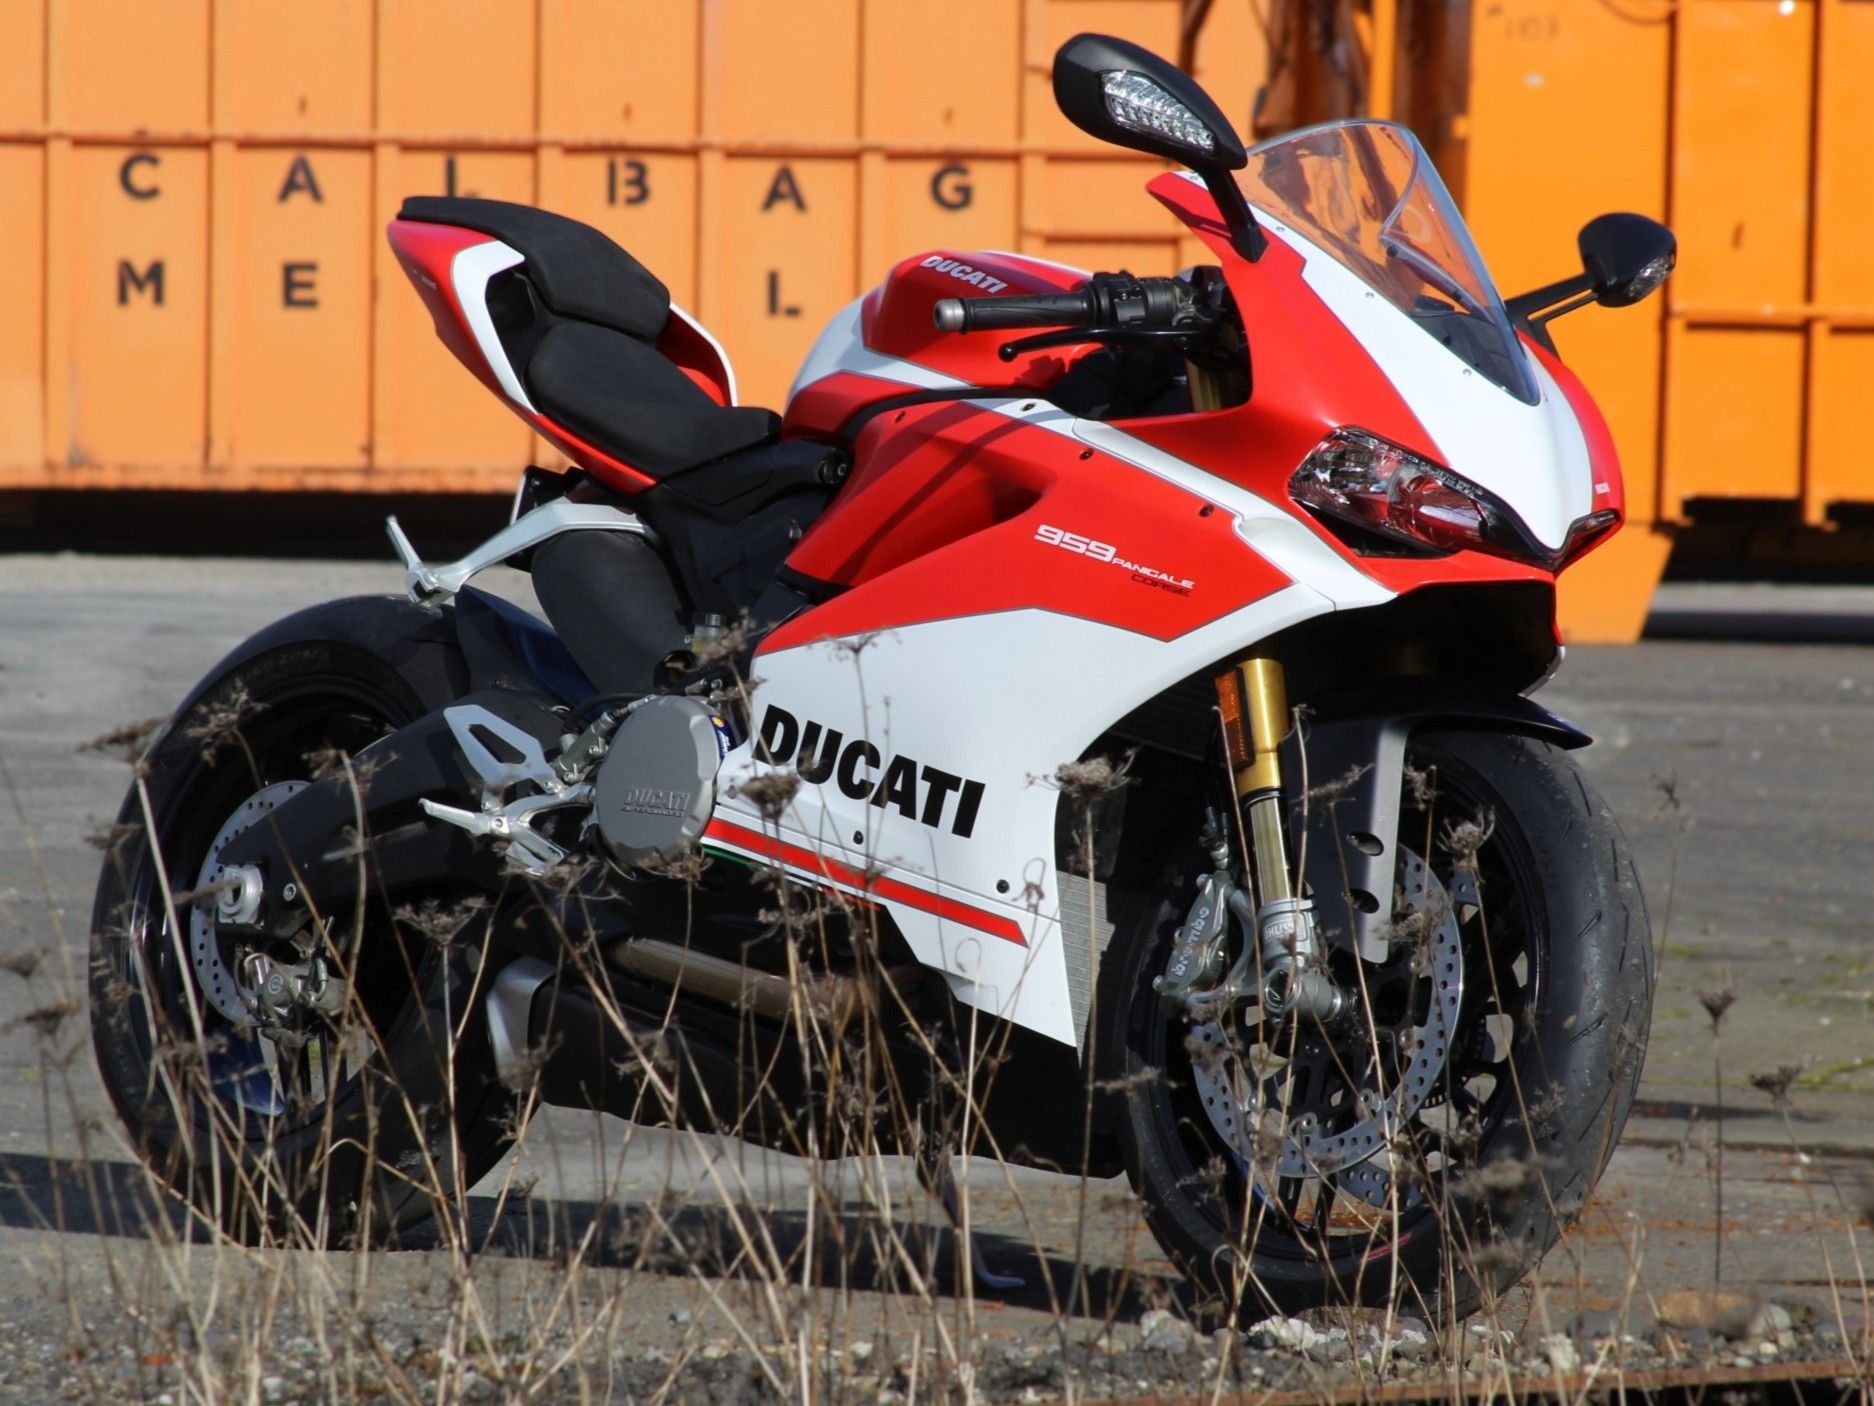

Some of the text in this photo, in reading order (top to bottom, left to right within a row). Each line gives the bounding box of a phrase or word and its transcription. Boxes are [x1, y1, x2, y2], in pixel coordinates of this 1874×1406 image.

[920, 255, 1008, 294] DUCATI
[1034, 524, 1195, 589] 959 PANIGALE
[1131, 573, 1192, 598] CORSE
[751, 703, 986, 839] DUCATI
